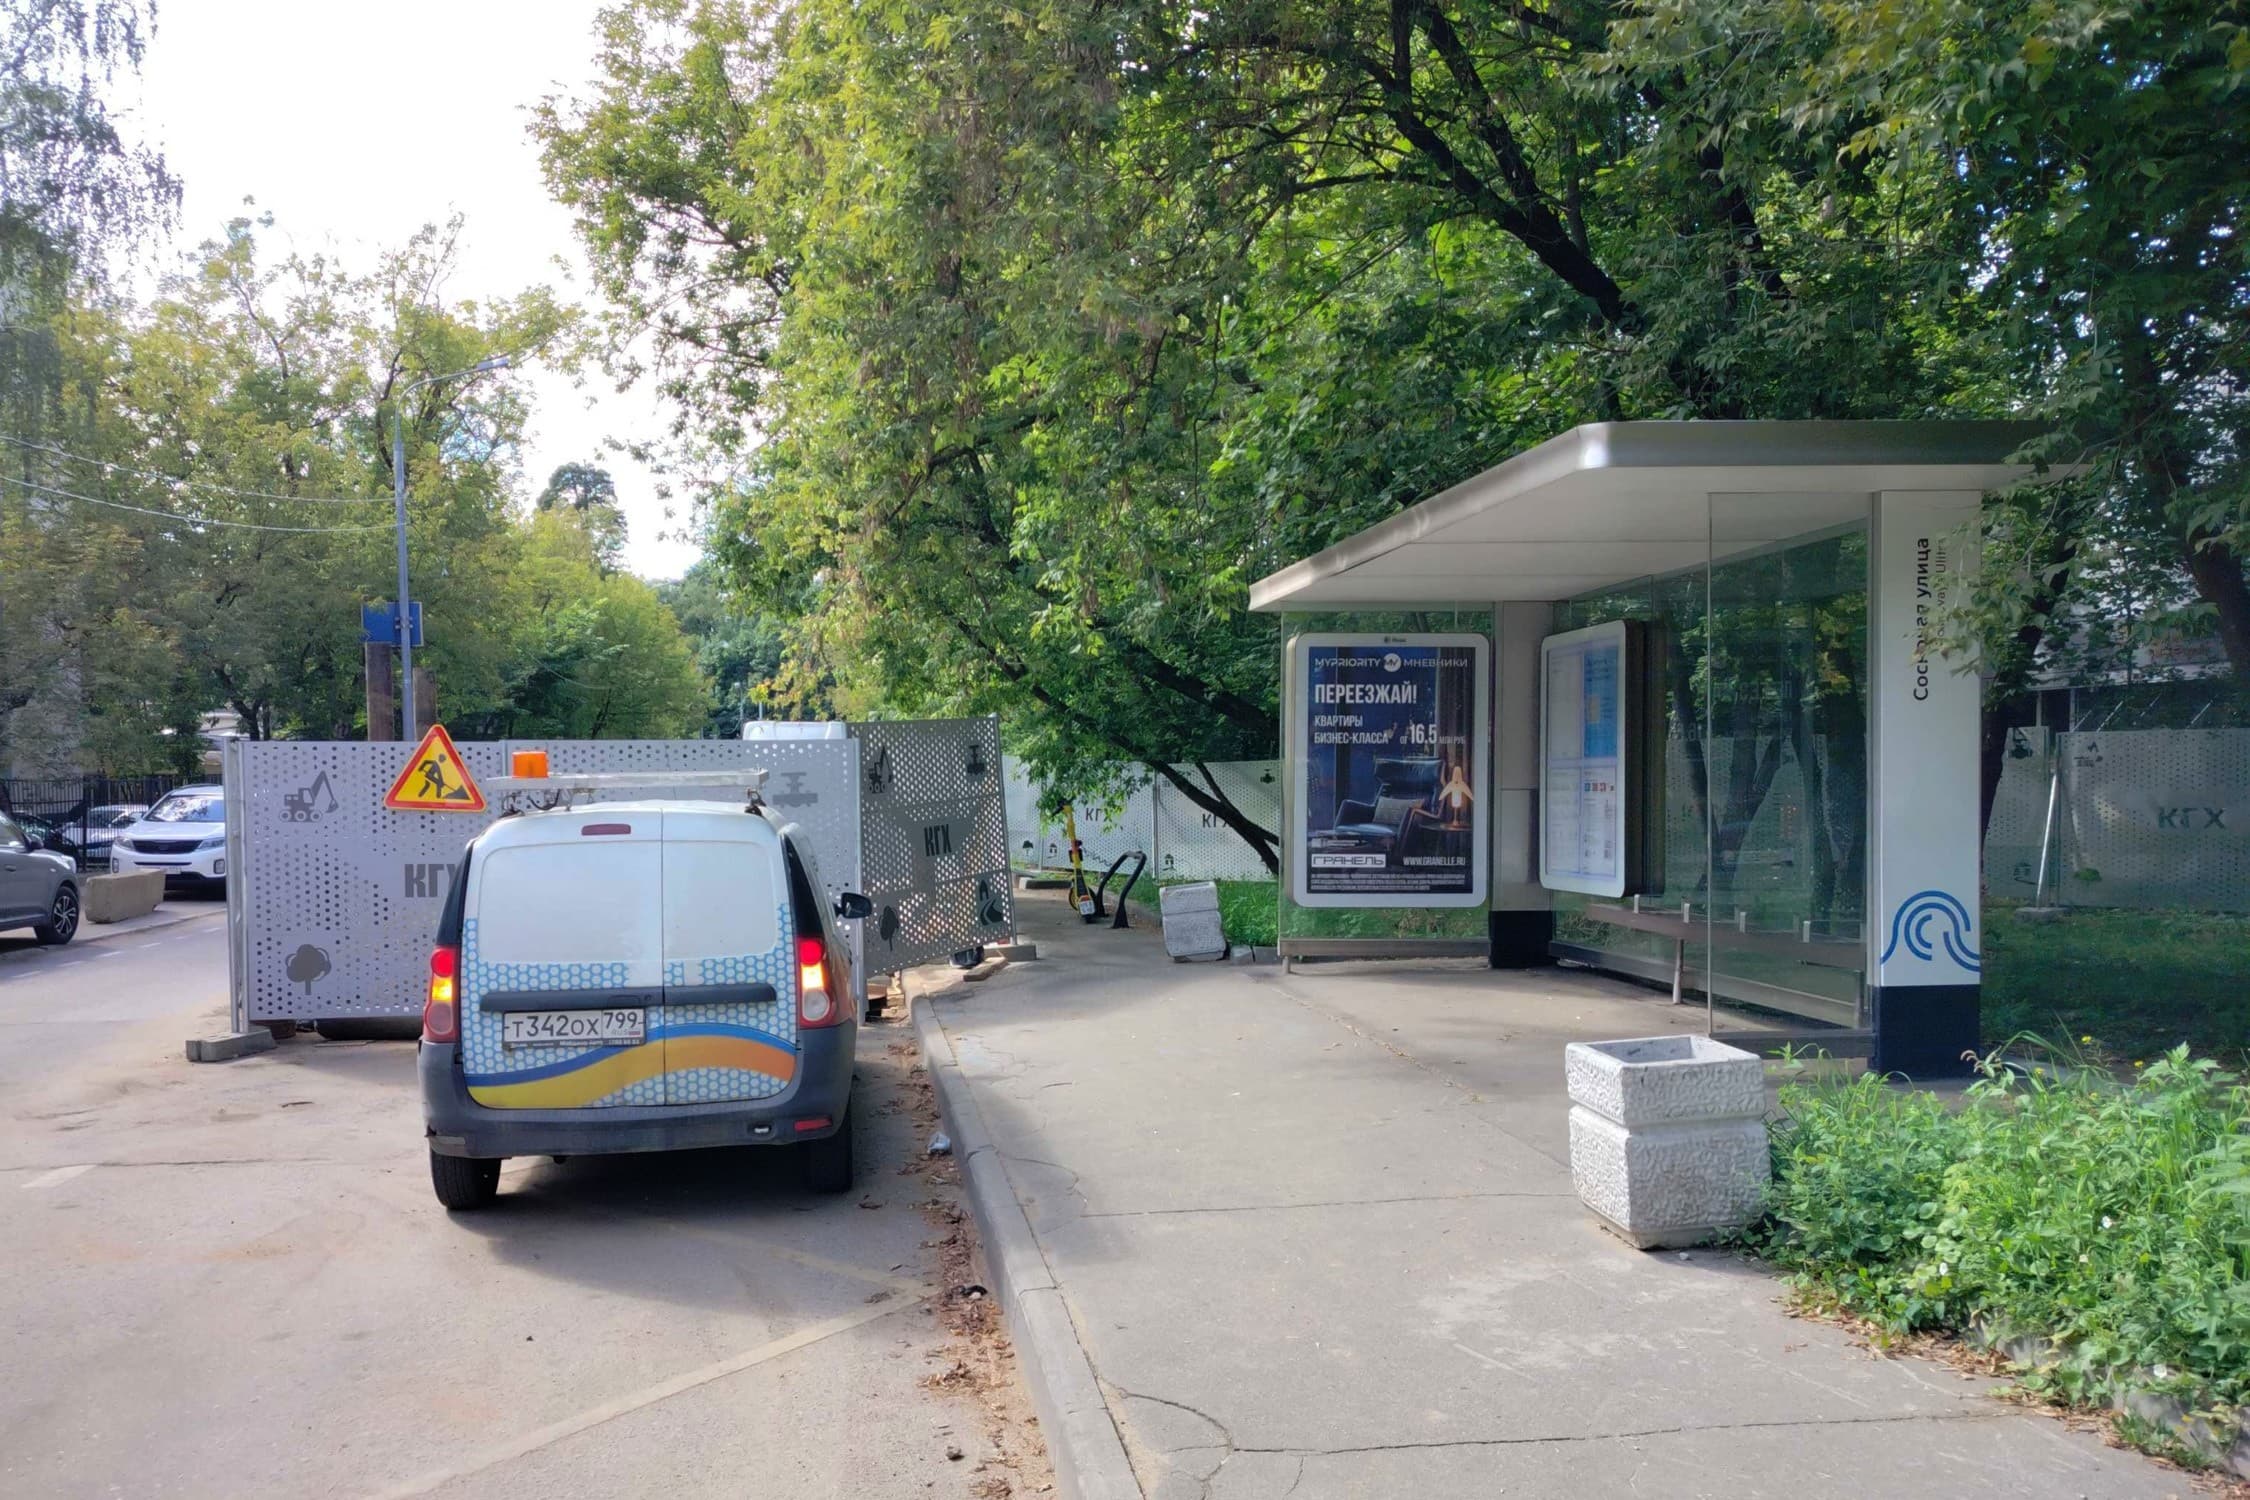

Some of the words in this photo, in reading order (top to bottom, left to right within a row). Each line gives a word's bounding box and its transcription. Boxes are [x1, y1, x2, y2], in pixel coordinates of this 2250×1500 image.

[1916, 538, 1931, 598] улица
[1314, 658, 1381, 668] MYPRIORITY
[1403, 658, 1468, 668] МНЕВНИКИ
[1315, 681, 1417, 704] ПЕРЕЕЗЖАЙ!
[1314, 714, 1363, 727] КВАРТИРЫ
[1314, 731, 1389, 744] БИЗНЕС-КЛАССА
[1410, 723, 1437, 745] 16.5
[2158, 807, 2225, 829] КГХ
[924, 823, 952, 857] КГХ
[1313, 856, 1384, 866] ГРАНЕЛЬ
[604, 1011, 638, 1029] 799
